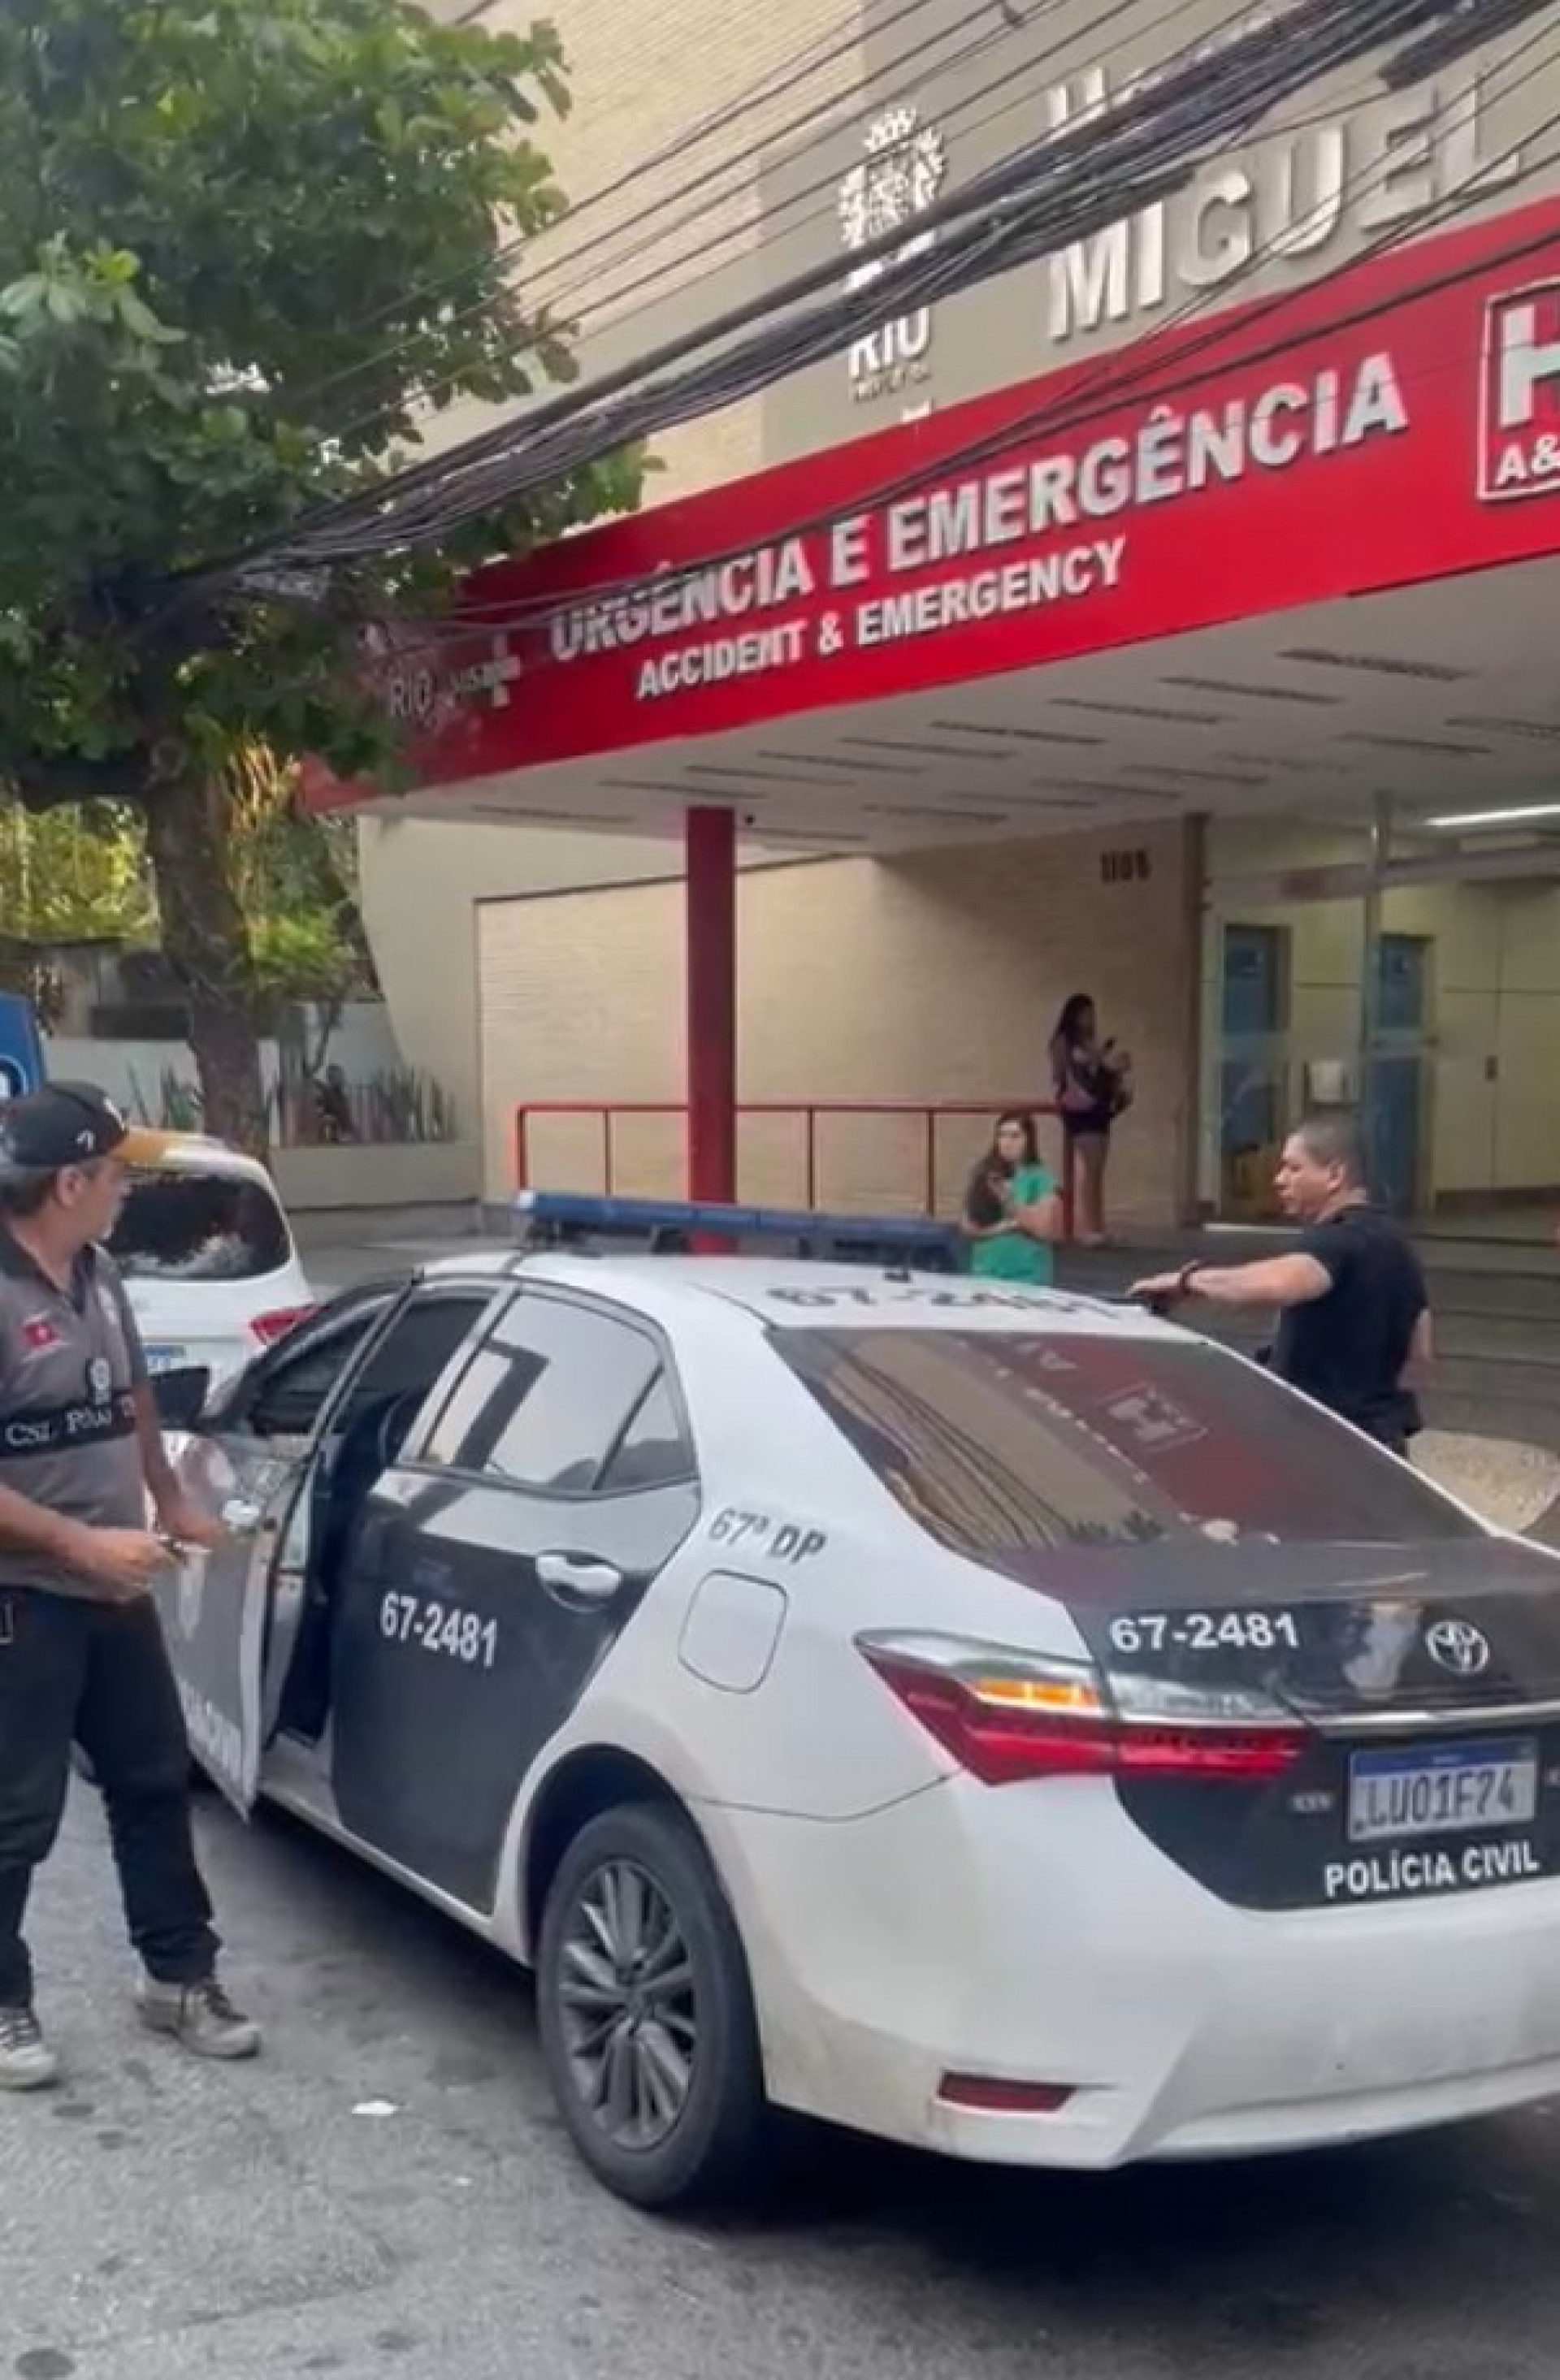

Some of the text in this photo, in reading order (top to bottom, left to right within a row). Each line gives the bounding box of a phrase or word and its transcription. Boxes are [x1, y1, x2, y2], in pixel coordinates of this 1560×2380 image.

[1051, 75, 1519, 338] MIGUEL
[549, 351, 1408, 661] URGÊNCIA E EMERGÊNCIA
[636, 536, 1126, 700] ACCIDENT & EMERGENCY
[769, 1524, 827, 1564] DP
[380, 1590, 498, 1668] 67-2481
[1109, 1612, 1300, 1653] 67-2481
[1325, 1841, 1540, 1898] POLÍCIA CIVIL
